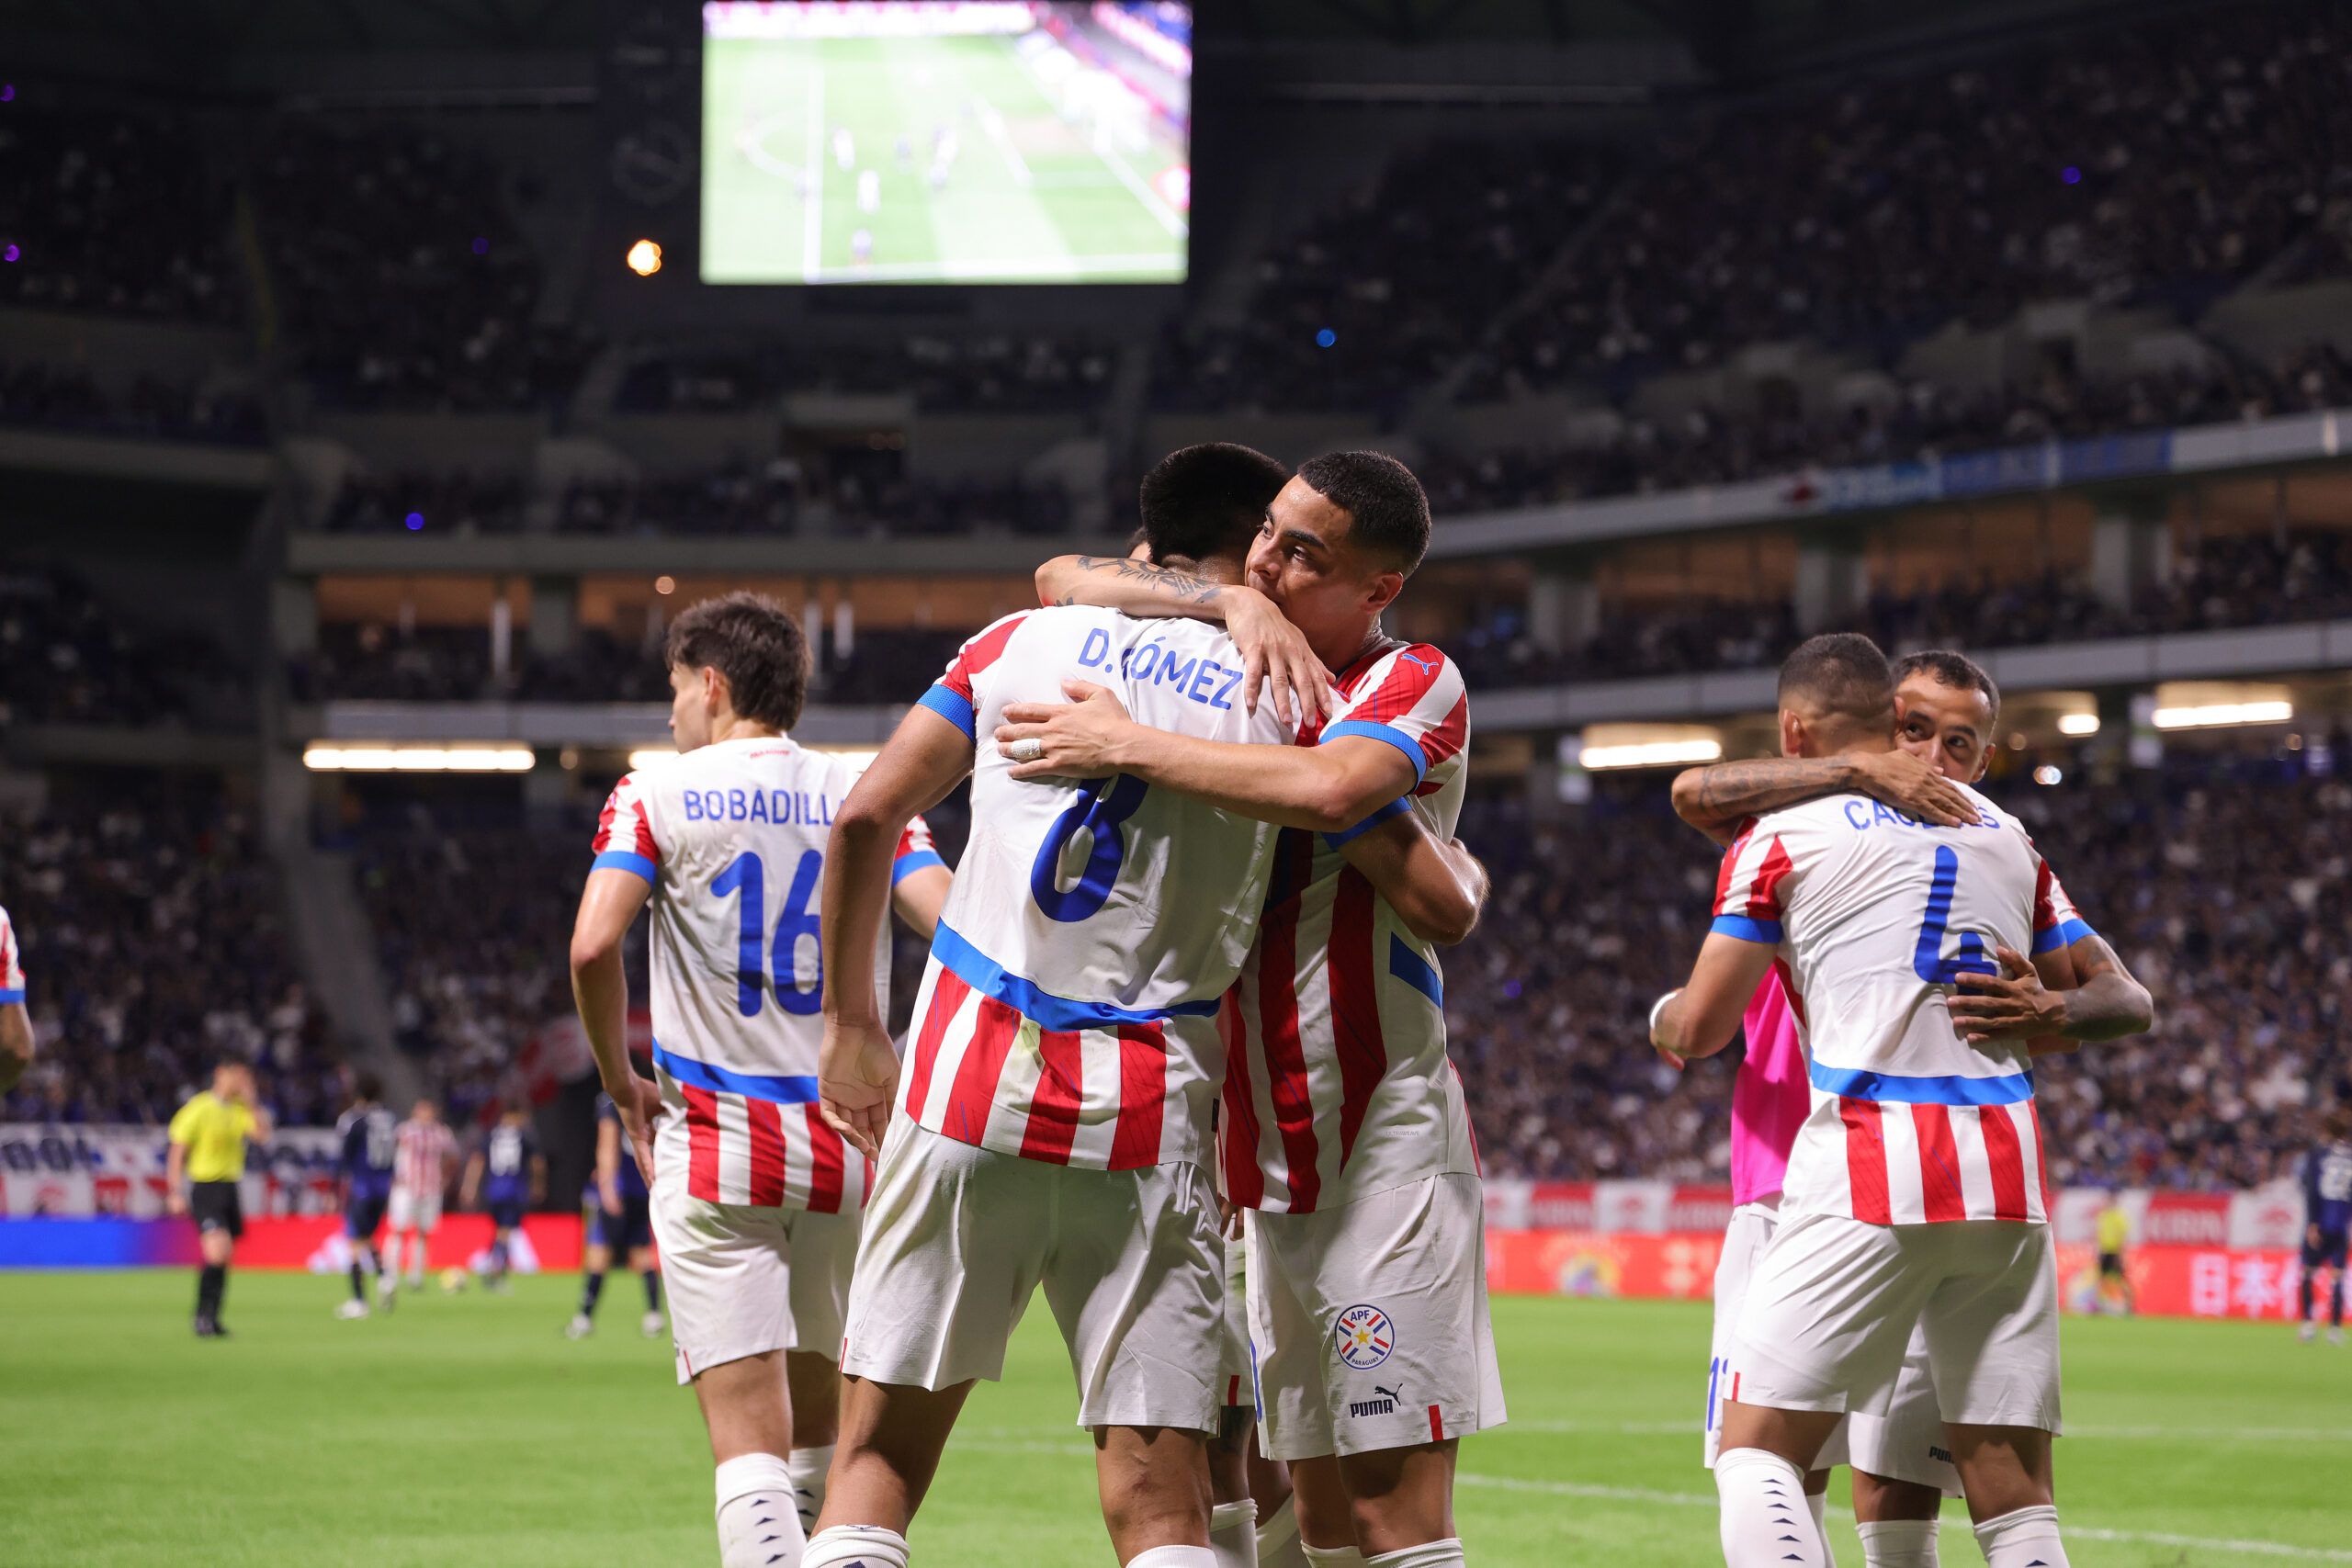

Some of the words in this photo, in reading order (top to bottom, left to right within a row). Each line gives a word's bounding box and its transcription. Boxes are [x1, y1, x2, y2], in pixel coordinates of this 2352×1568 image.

[683, 788, 844, 827] BOBADILL
[1030, 772, 1150, 923] 8
[709, 849, 825, 1018] 16
[1913, 844, 1998, 996] 4
[1350, 1309, 1370, 1321] APF
[1351, 1356, 1379, 1366] PARAGUAY
[1350, 1399, 1394, 1418] PUMA
[1929, 1446, 1955, 1464] PUM
